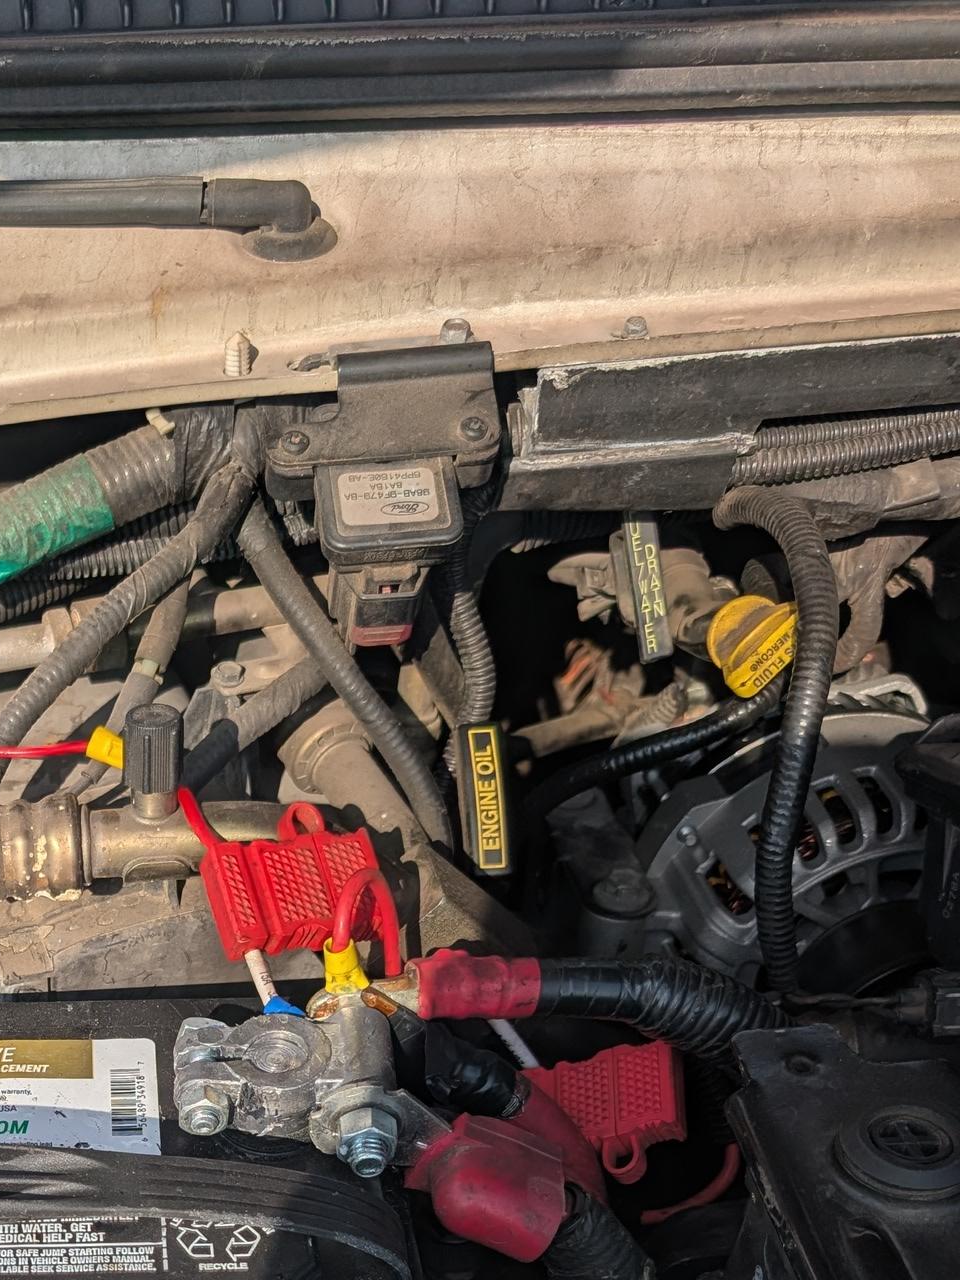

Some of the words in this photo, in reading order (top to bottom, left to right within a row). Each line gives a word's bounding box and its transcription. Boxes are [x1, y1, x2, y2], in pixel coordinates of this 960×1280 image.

[644, 544, 666, 618] DRAIN
[629, 522, 657, 654] UEL/WATER
[753, 656, 785, 688] FLUID
[475, 745, 495, 776] OIL
[478, 779, 500, 850] ENGINE
[21, 1222, 67, 1233] WATER.
[70, 1221, 93, 1232] GET
[42, 1232, 73, 1243] HELP
[75, 1231, 106, 1242] FAST
[15, 1248, 38, 1257] SAFE
[40, 1248, 68, 1257] JUMP
[69, 1247, 114, 1256] STARTING
[115, 1246, 154, 1255] FOLLOW
[19, 1256, 29, 1265] IN
[30, 1256, 69, 1265] VEHICLE
[70, 1255, 111, 1264] OWNERS
[112, 1255, 155, 1263] MANUAL.
[31, 1264, 54, 1273] SEEK
[55, 1264, 94, 1273] SERVICE
[96, 1263, 157, 1272] ASSISTANCE.
[198, 1262, 249, 1271] RECYCLE
